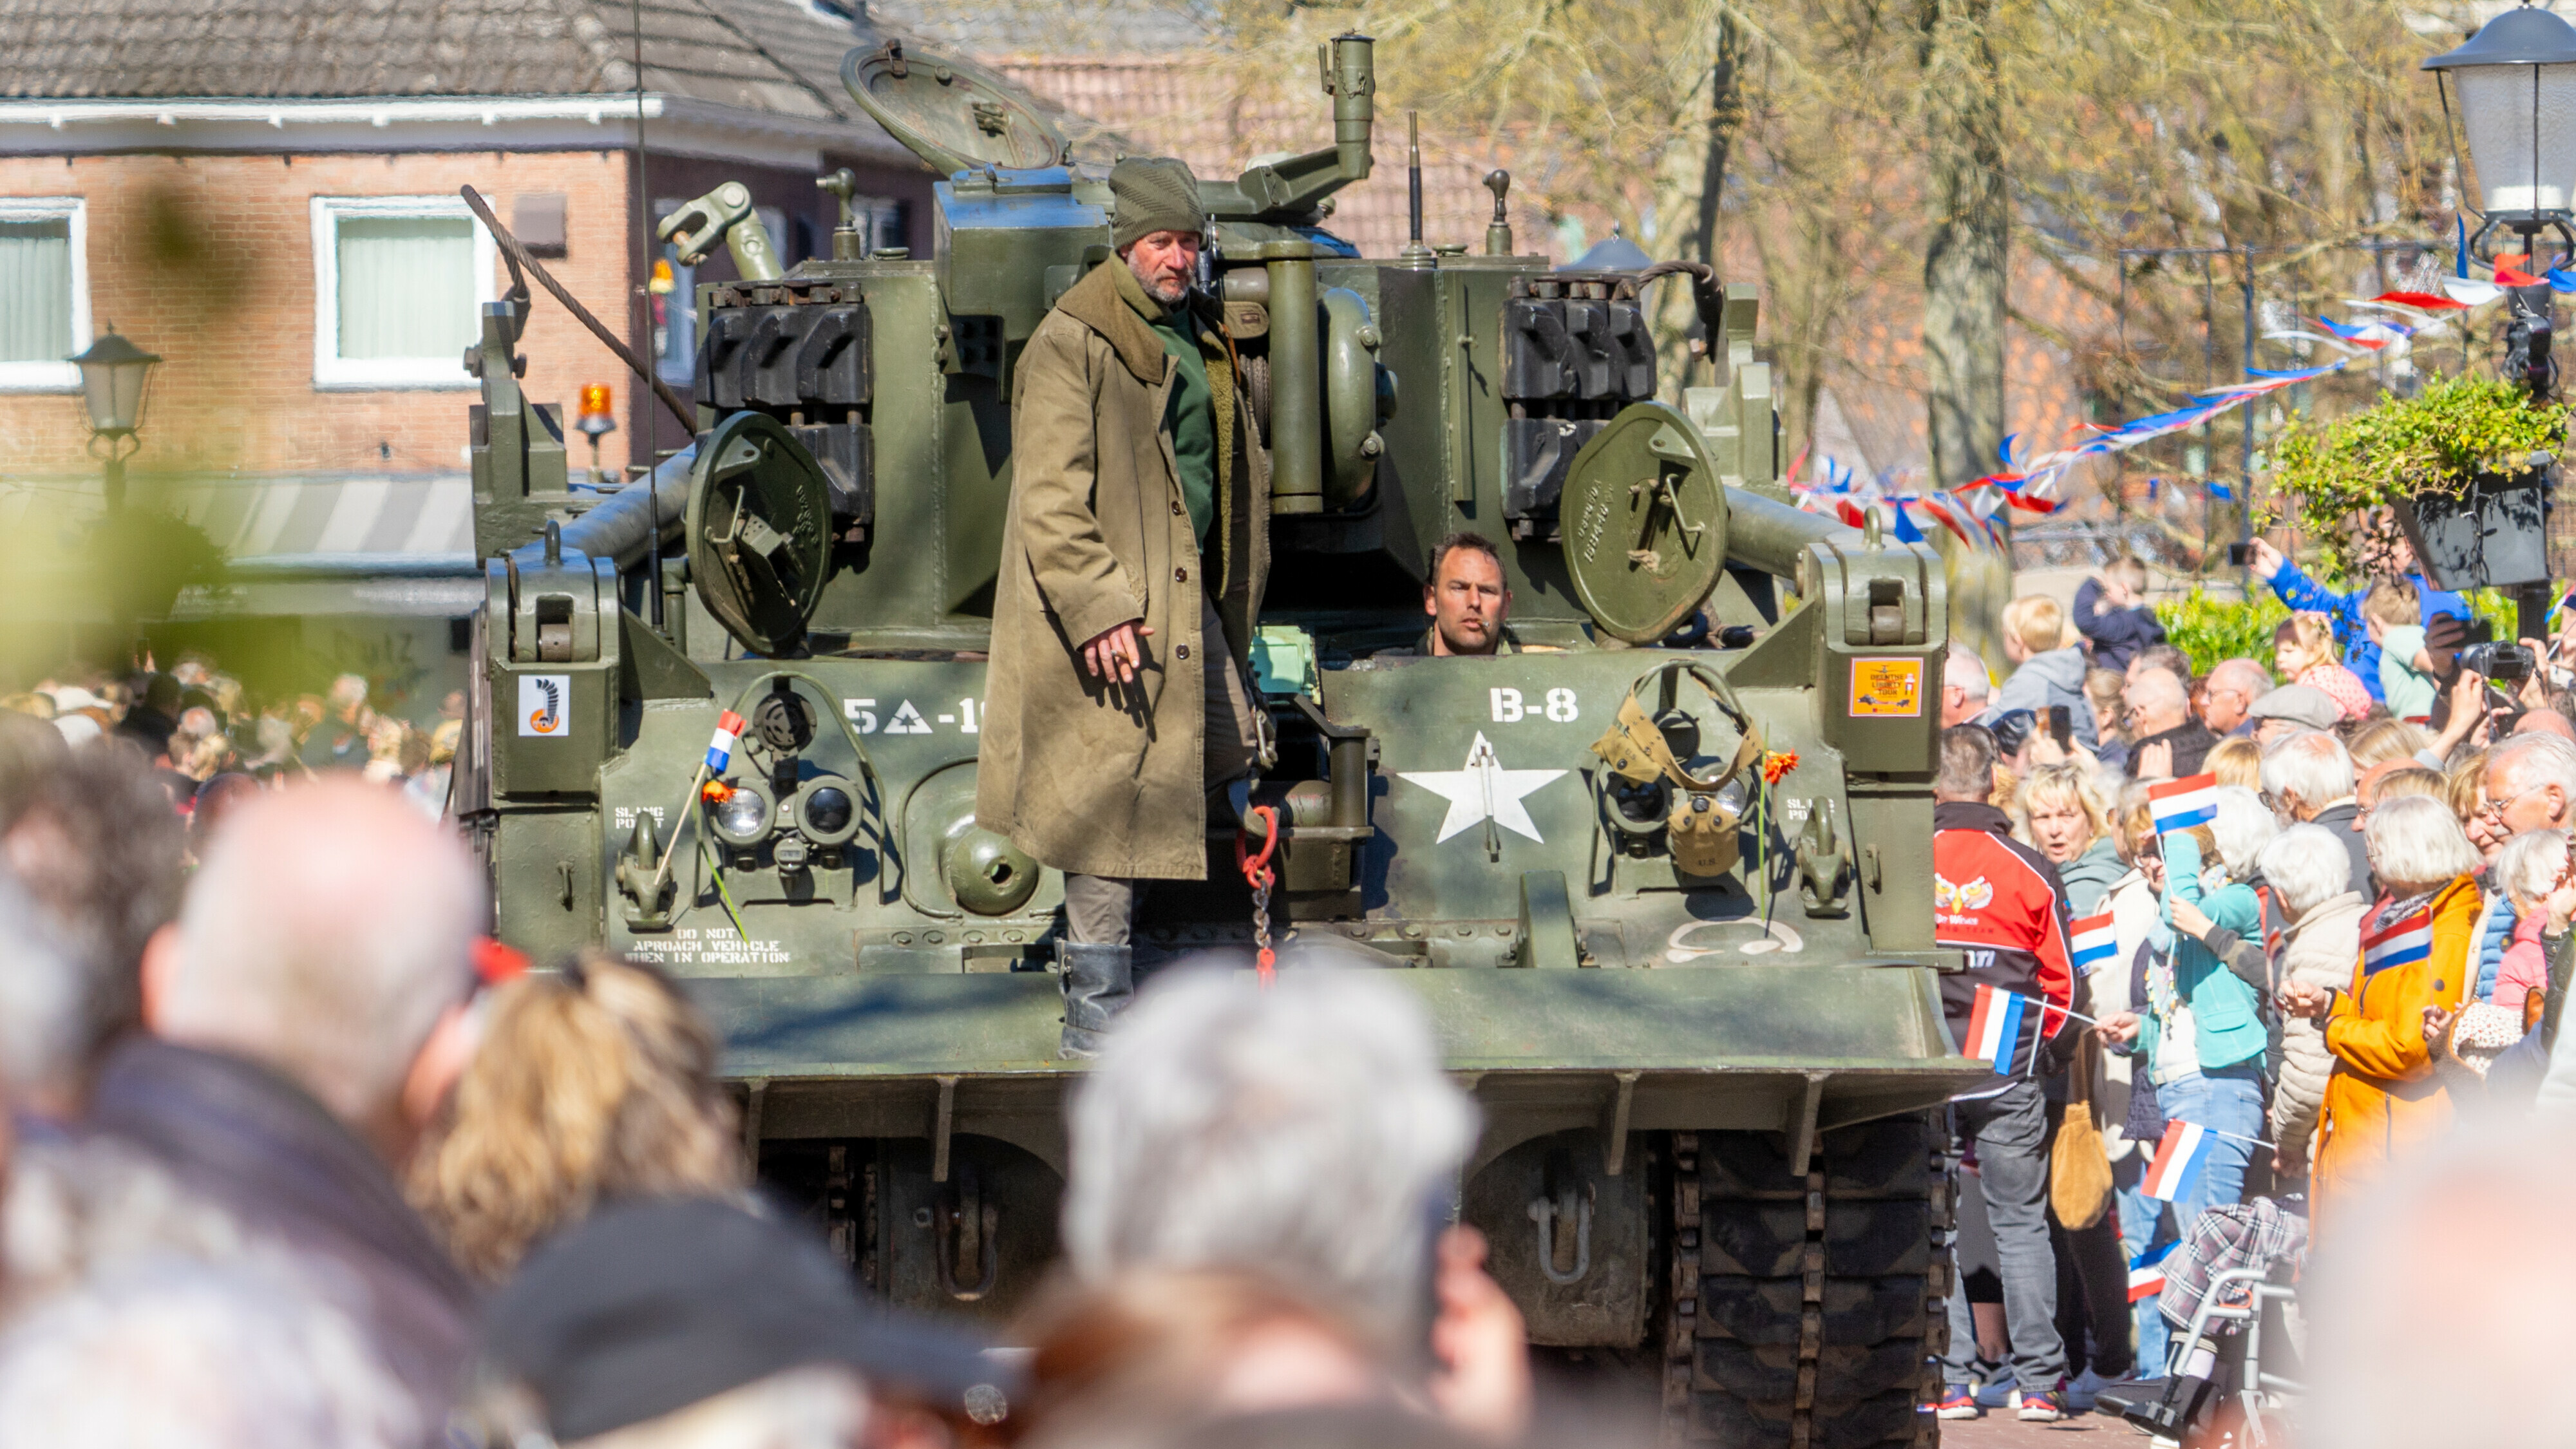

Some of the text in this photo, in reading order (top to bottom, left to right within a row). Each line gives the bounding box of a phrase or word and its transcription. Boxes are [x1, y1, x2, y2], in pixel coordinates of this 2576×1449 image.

[1490, 687, 1579, 723] B-8
[616, 817, 665, 829] POT
[677, 927, 735, 940] DO NOT
[632, 940, 781, 952] APROACH VEHICLE
[674, 951, 692, 963] IN
[700, 951, 790, 963] OPERATION
